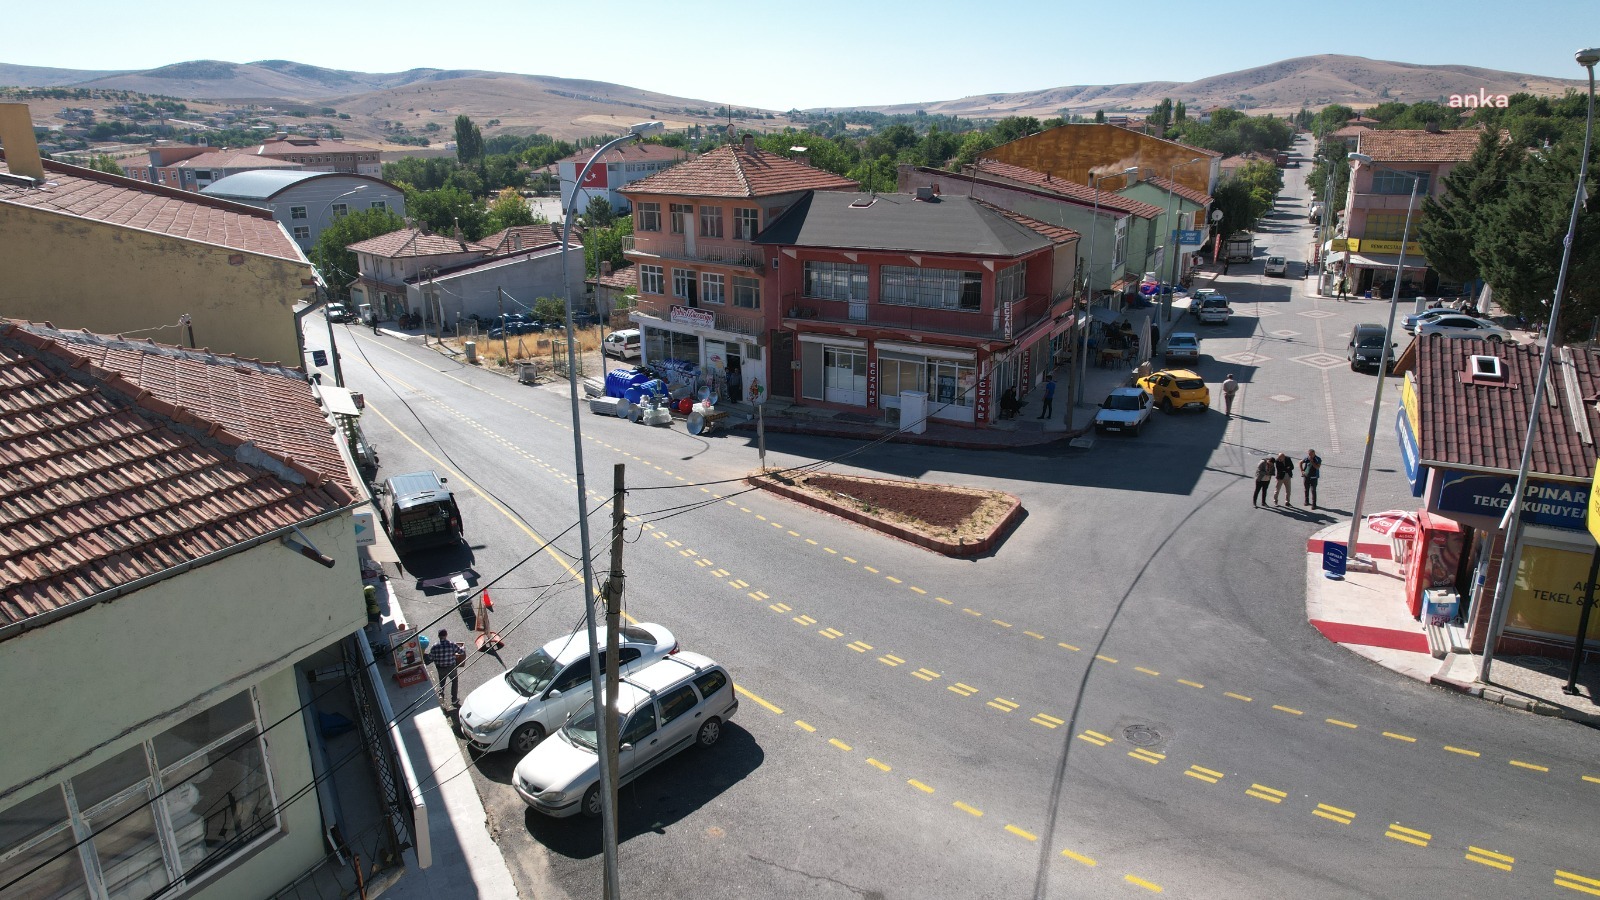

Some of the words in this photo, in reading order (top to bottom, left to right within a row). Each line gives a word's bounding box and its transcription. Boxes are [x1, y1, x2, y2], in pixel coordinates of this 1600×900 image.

[1003, 301, 1011, 340] ECZANE
[1473, 494, 1509, 509] TEKE
[1498, 482, 1586, 503] APINAR
[1533, 589, 1573, 605] TEKEL
